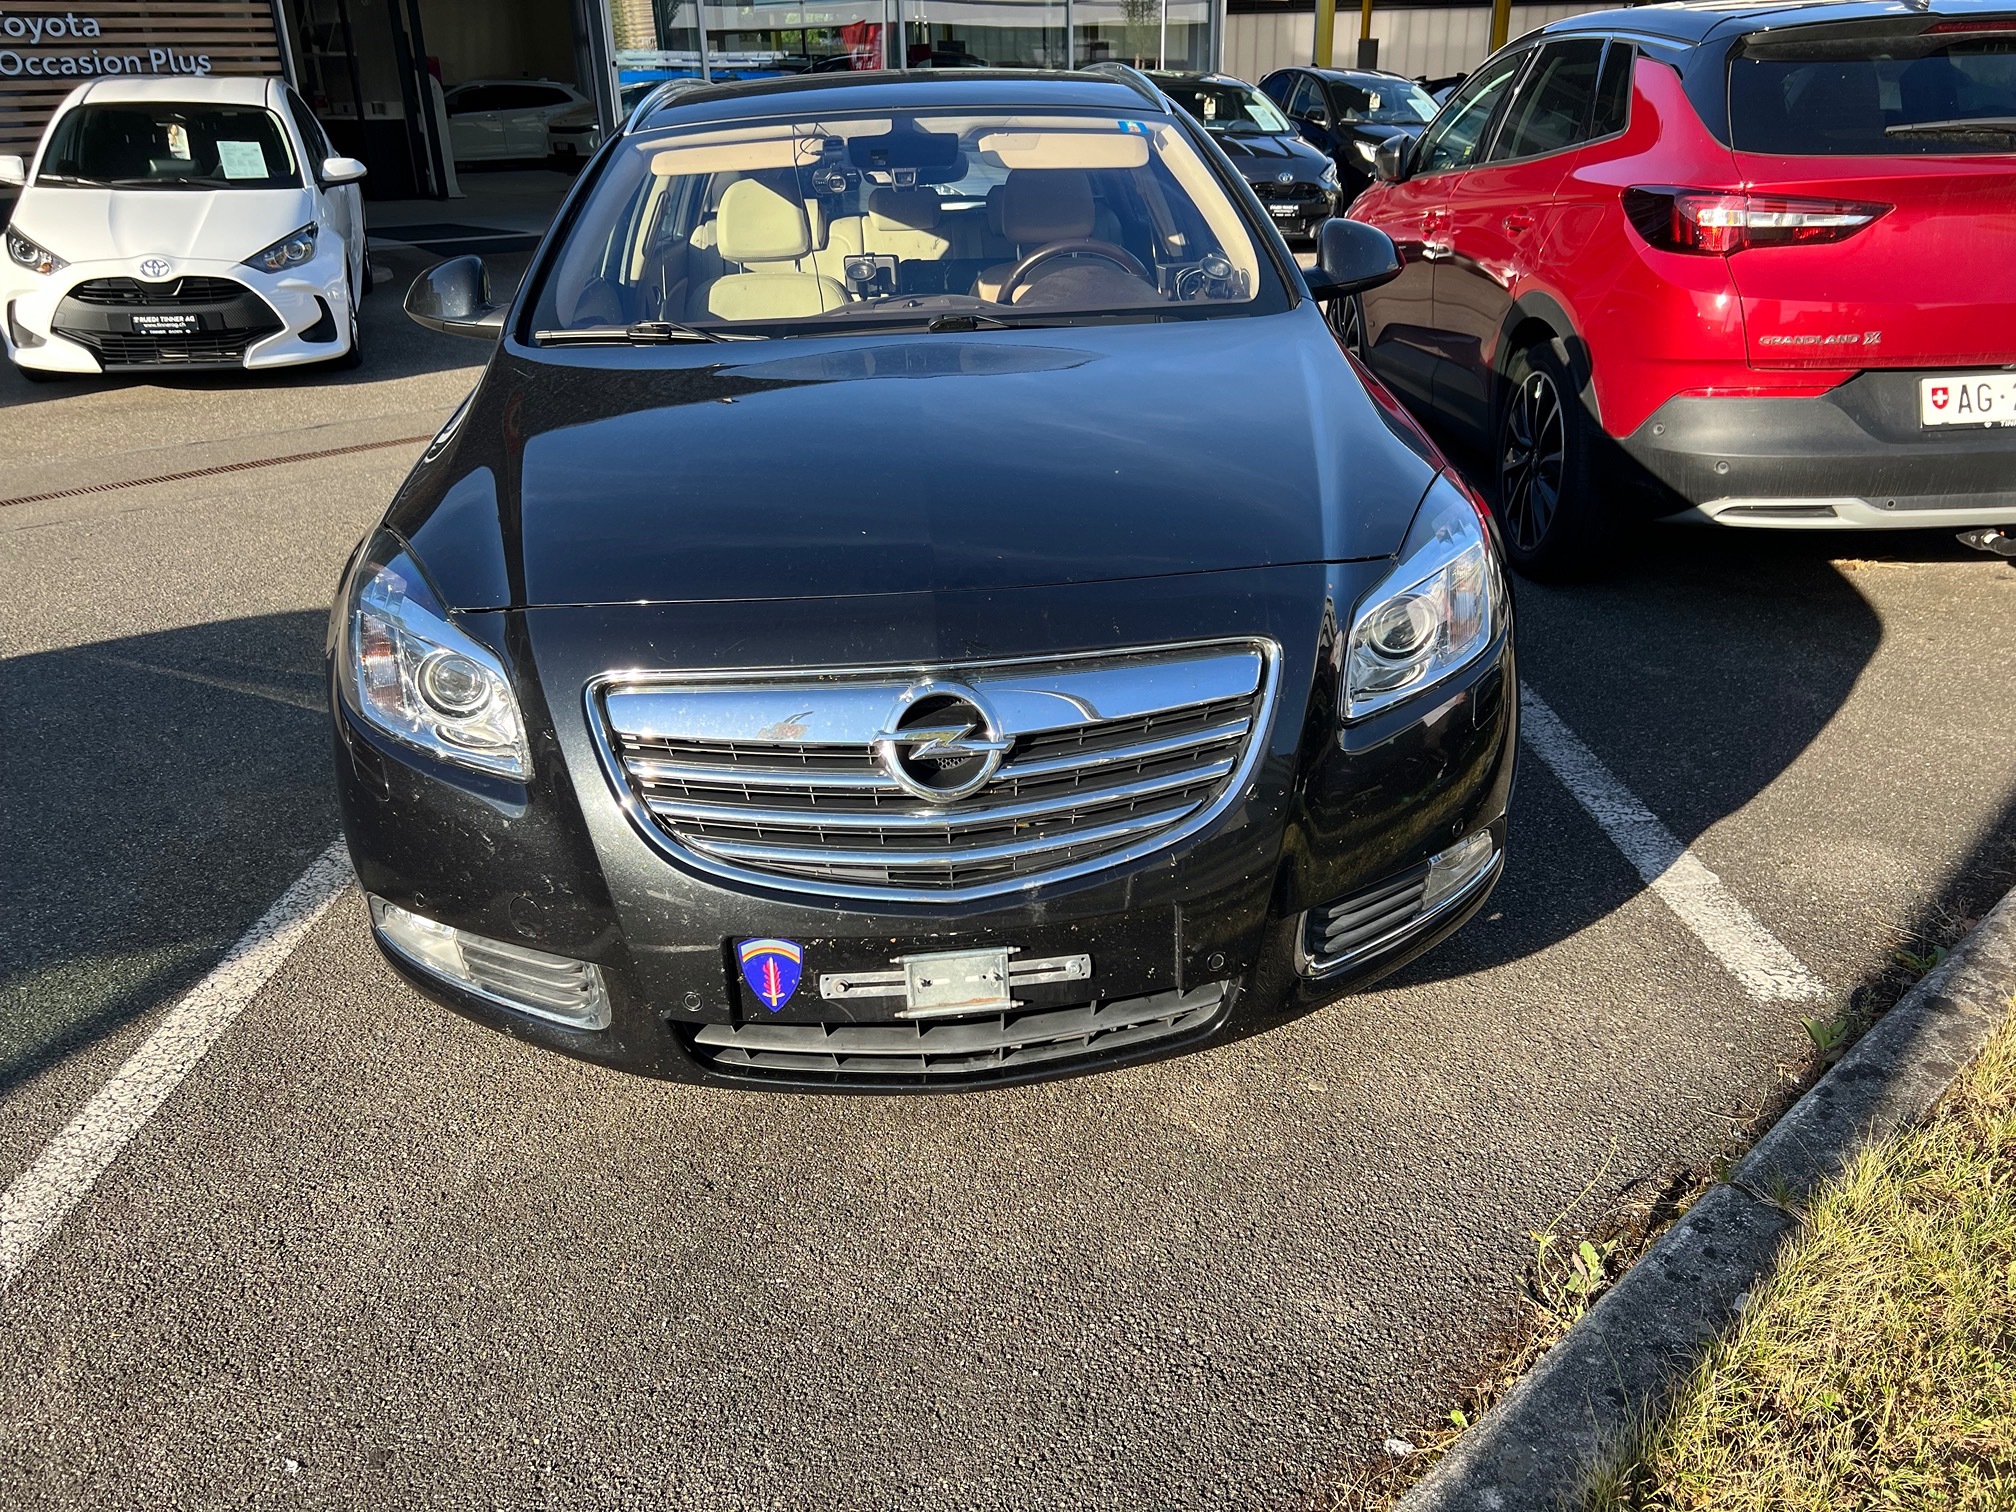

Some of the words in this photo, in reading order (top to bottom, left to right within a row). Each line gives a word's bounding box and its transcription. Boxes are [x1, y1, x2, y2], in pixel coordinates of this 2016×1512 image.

[0, 10, 100, 44] oyota
[0, 49, 142, 76] Occasion
[149, 47, 212, 73] Plus
[1759, 335, 1860, 345] GRANDLAND
[1862, 331, 1882, 345] X
